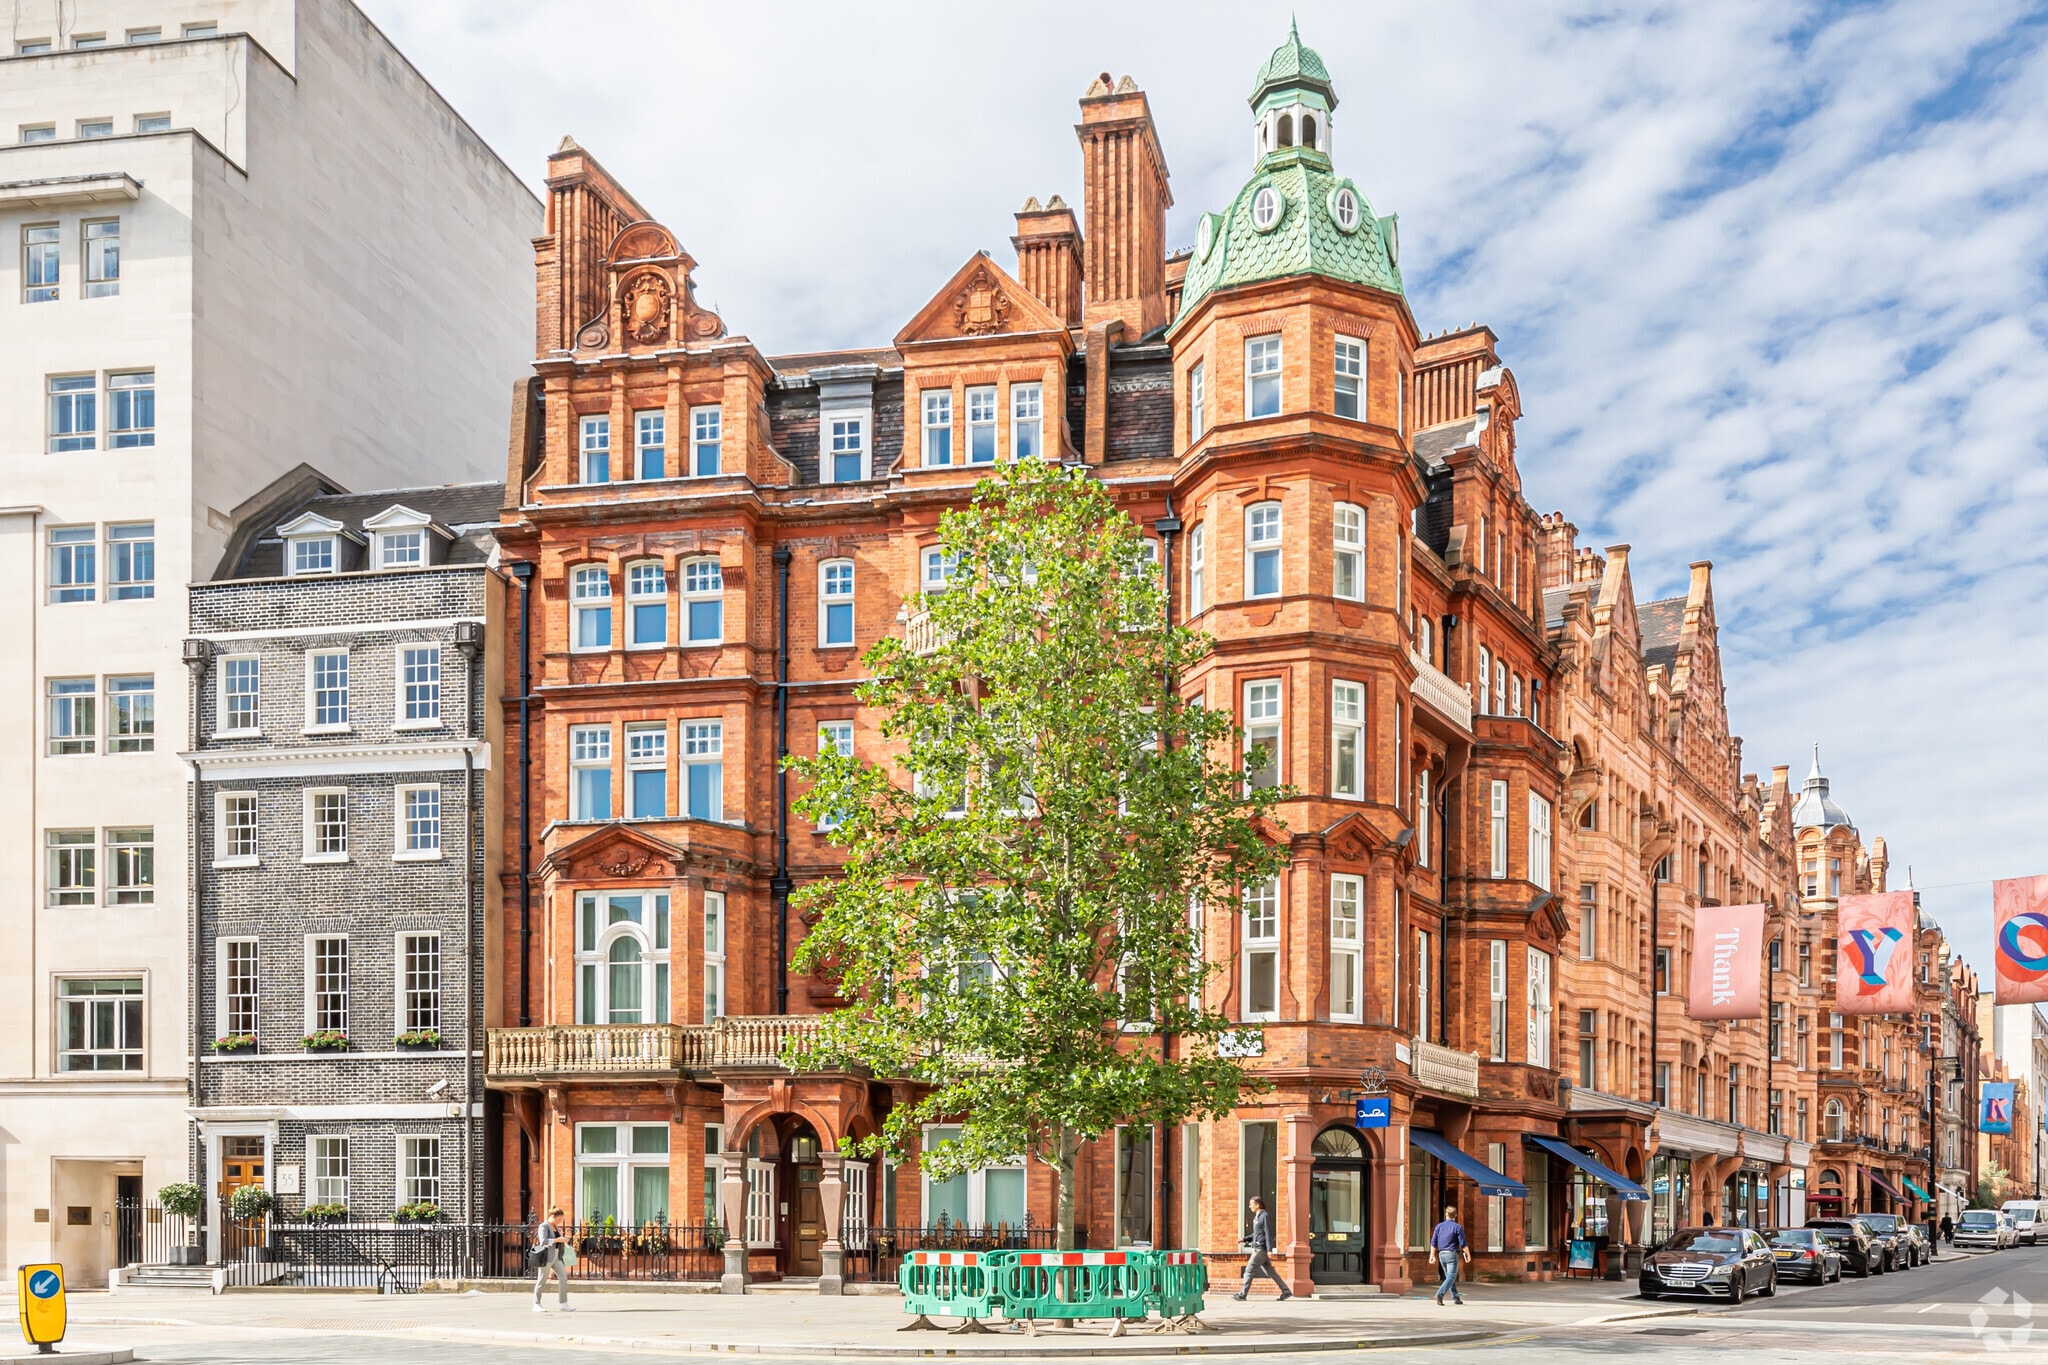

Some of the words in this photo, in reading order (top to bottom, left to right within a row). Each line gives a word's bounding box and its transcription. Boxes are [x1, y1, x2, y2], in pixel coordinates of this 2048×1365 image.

[1712, 927, 1740, 1007] Thank
[1847, 927, 1903, 986] Y
[1998, 912, 2048, 971] O
[1986, 1097, 2009, 1123] K
[281, 1173, 294, 1187] 35
